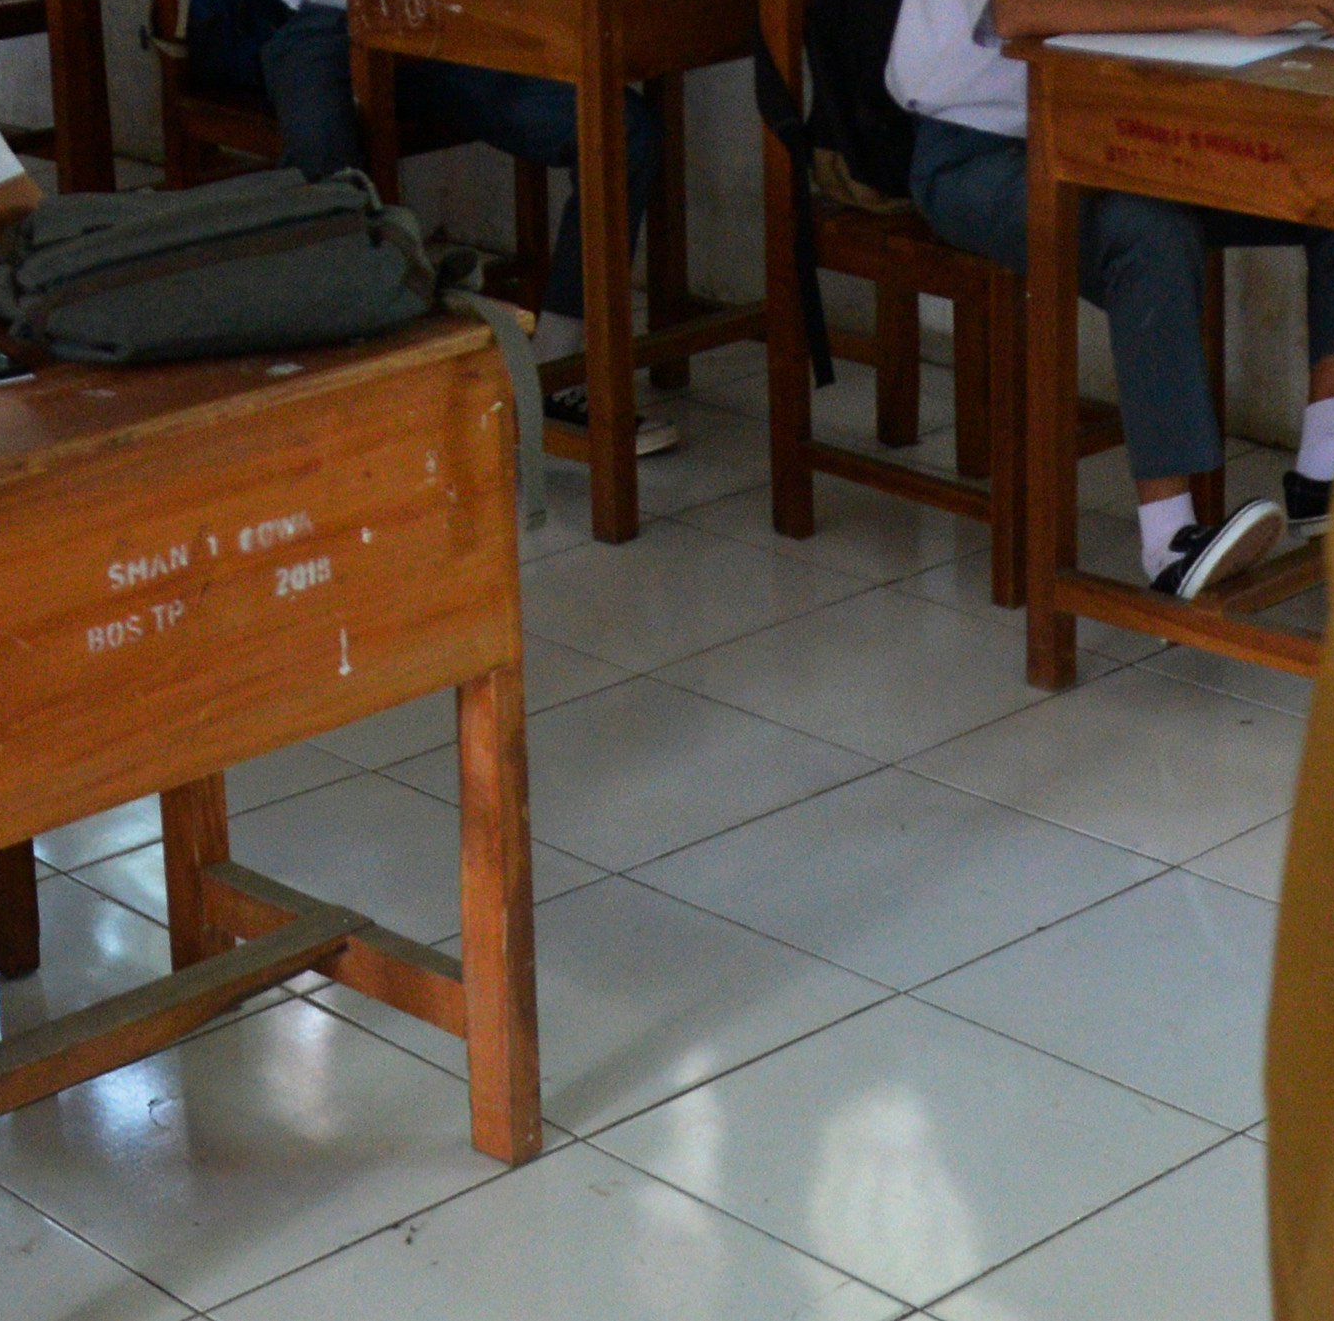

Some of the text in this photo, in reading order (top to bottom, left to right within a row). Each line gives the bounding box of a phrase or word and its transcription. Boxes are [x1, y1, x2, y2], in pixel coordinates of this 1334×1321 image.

[107, 543, 189, 591] SMAN
[207, 533, 219, 558] 1
[86, 613, 144, 653] BOS
[150, 598, 186, 632] TP
